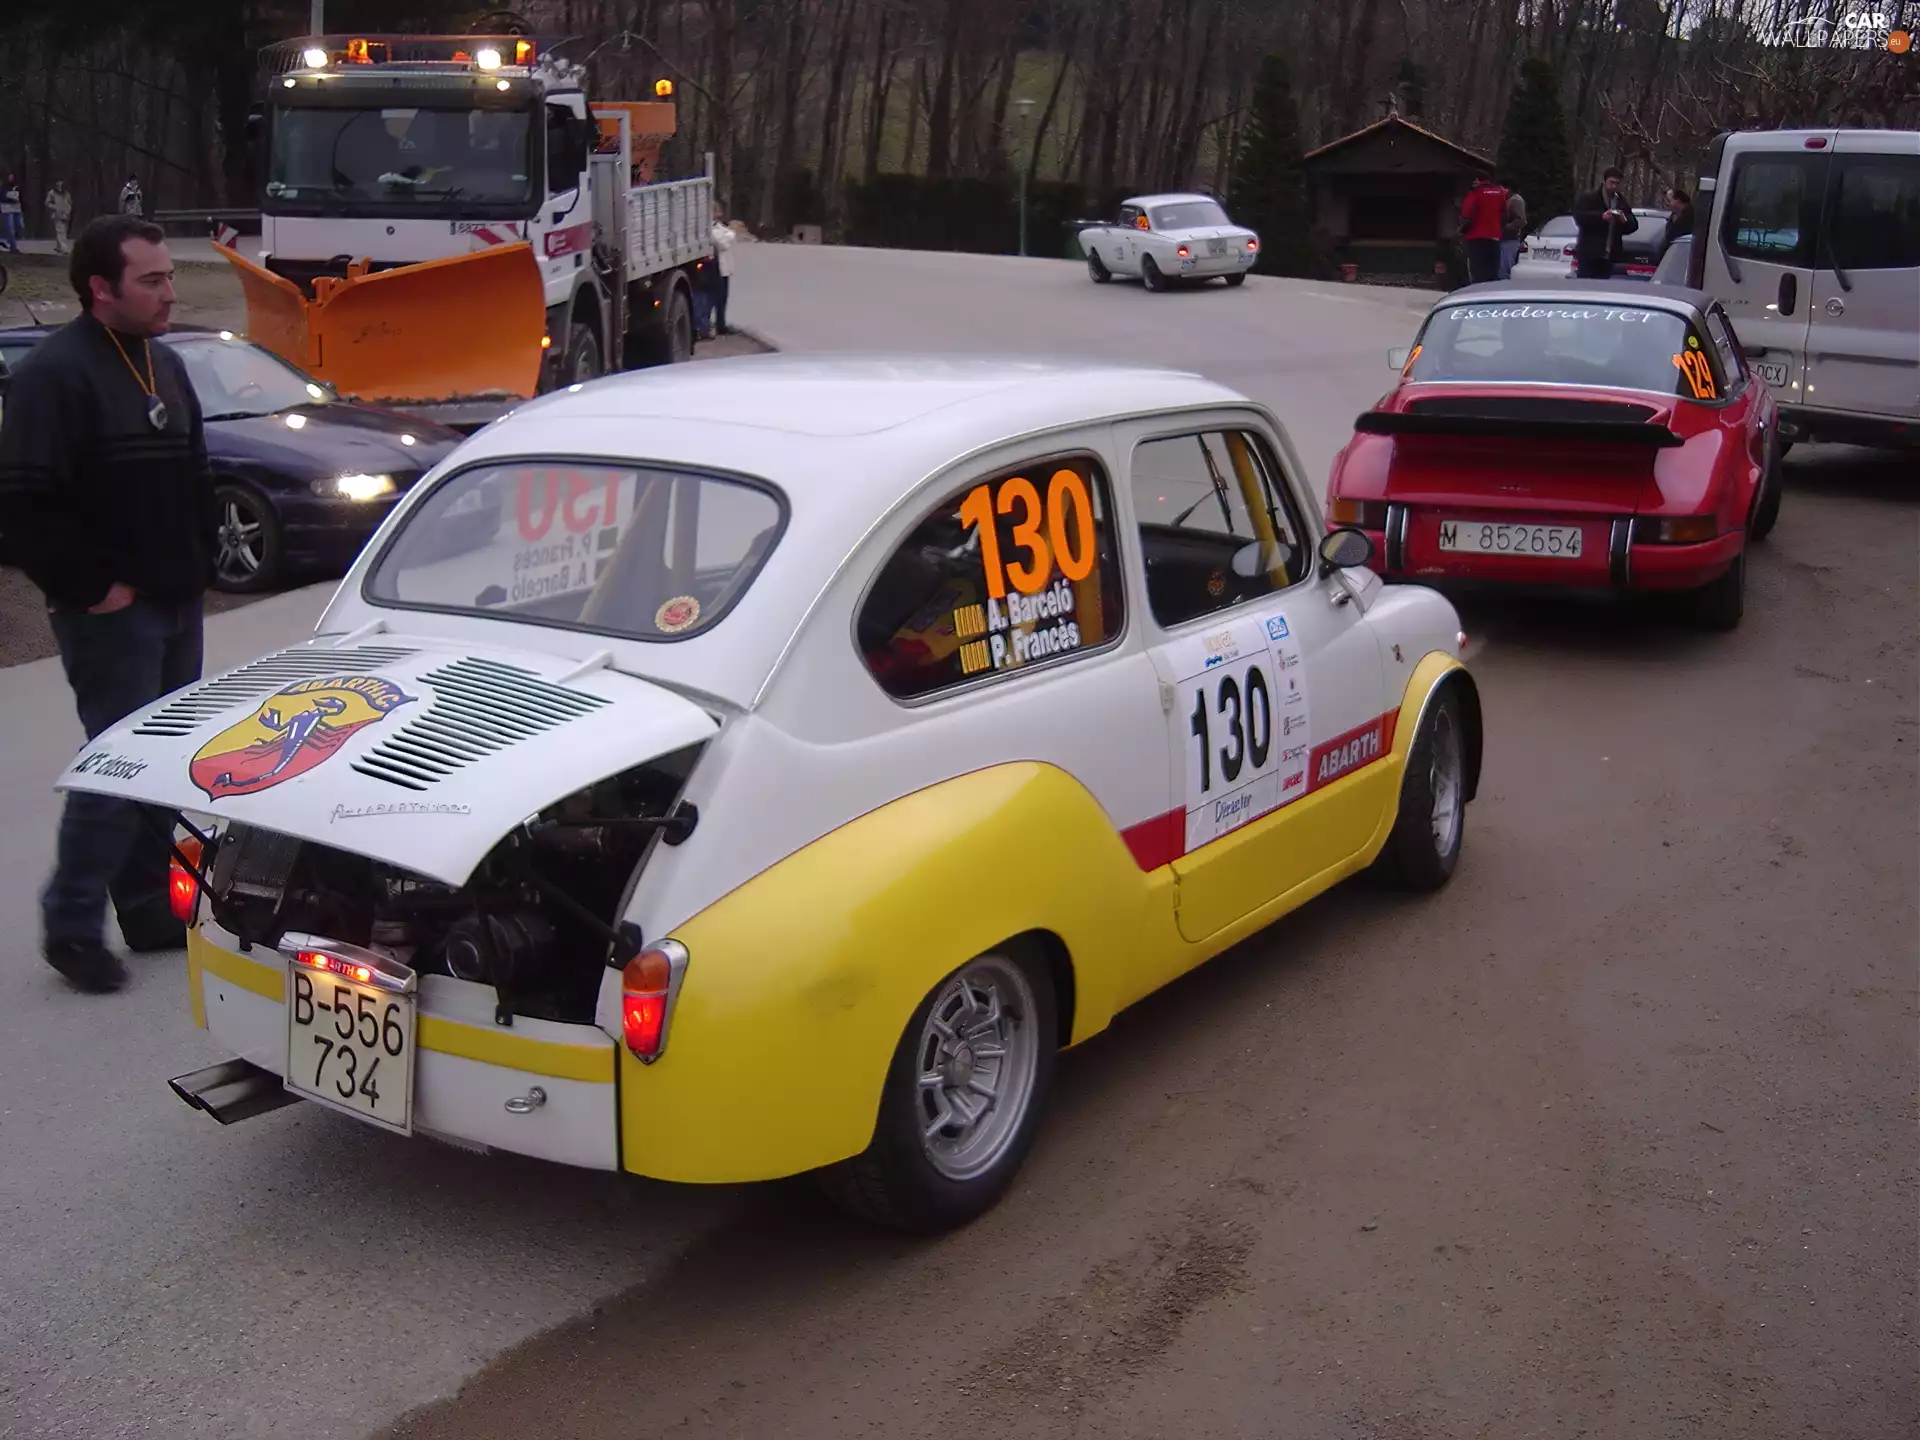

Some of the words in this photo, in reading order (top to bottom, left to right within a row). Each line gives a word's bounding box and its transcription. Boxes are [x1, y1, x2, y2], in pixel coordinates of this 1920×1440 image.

[1672, 351, 1716, 399] 129
[960, 469, 1096, 599] 130
[987, 598, 1009, 632] A.
[1007, 578, 1074, 625] Barceló
[989, 633, 1012, 669] P.
[1190, 664, 1271, 794] 130
[1317, 729, 1379, 782] ABARTH
[295, 971, 404, 1056] B-556
[314, 1035, 380, 1108] 734
